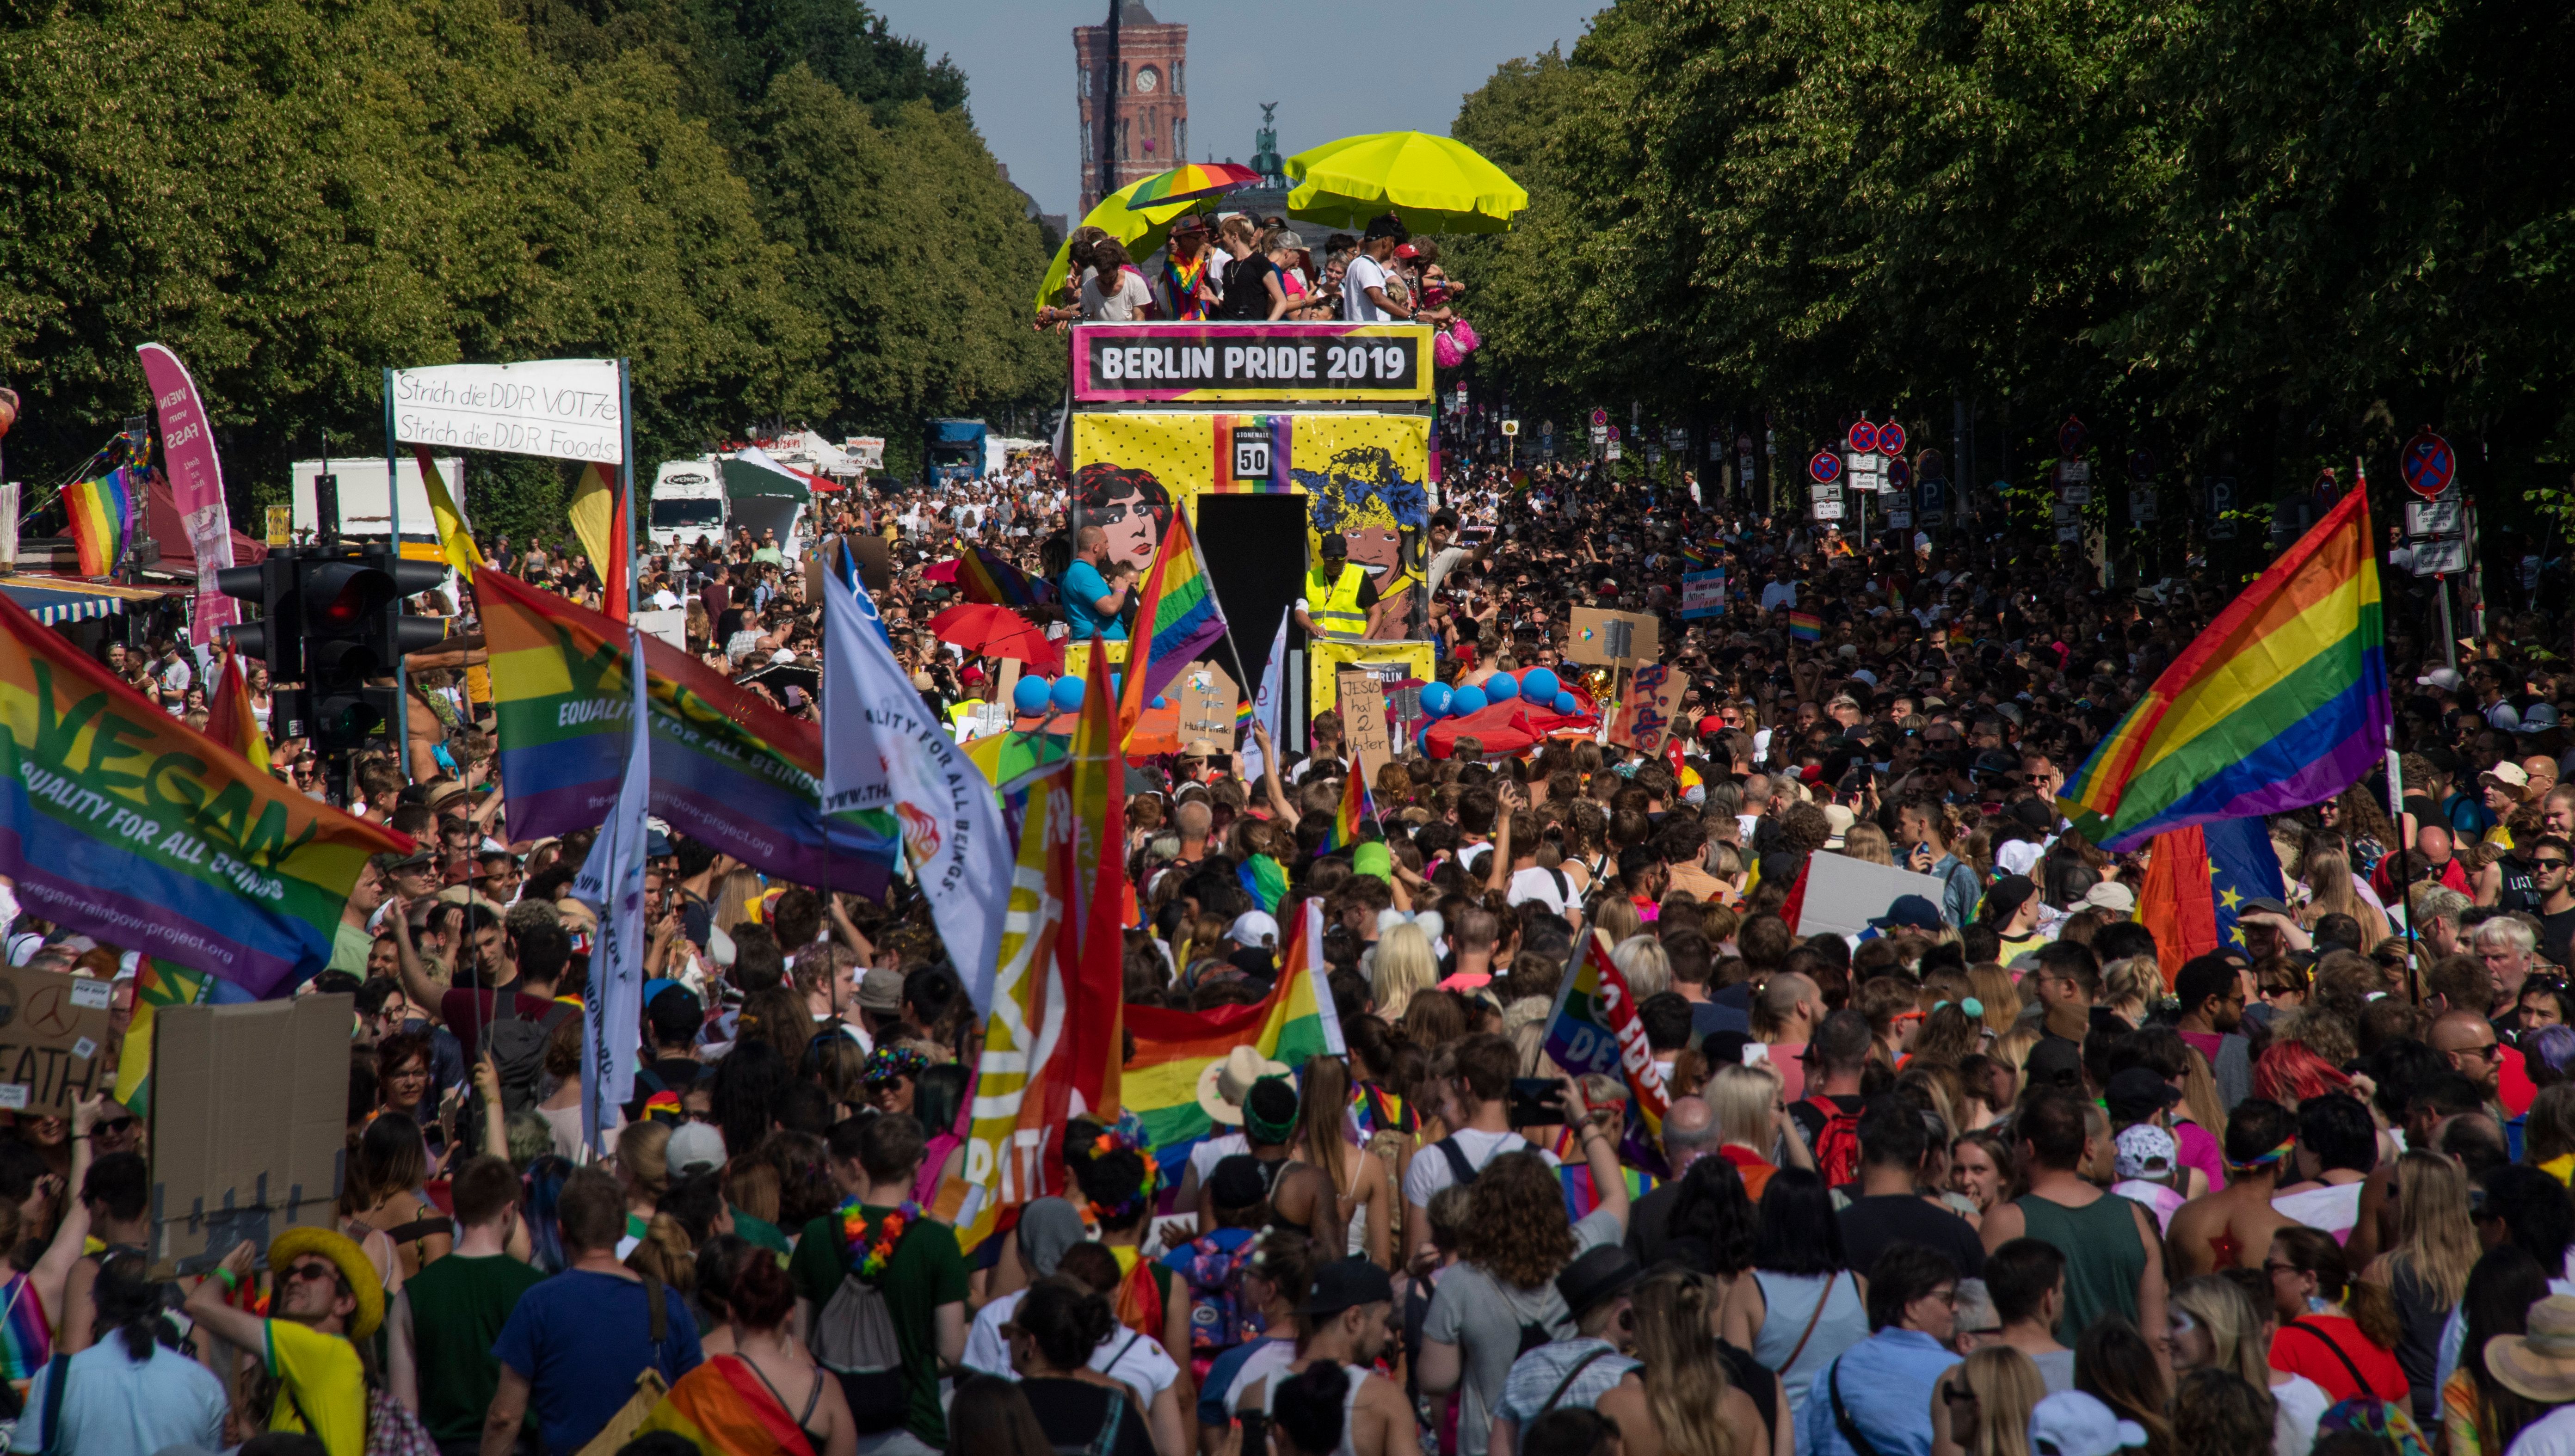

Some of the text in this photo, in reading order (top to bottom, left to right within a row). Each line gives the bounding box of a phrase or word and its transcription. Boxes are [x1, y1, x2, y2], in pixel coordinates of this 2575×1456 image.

[1102, 346, 1405, 379] BERLIN PRIDE 2019
[397, 375, 454, 404] Strich
[460, 384, 487, 406] die
[490, 383, 535, 411] DDR
[399, 415, 616, 460] Strich die DDR Foods
[1240, 449, 1266, 471] 50
[1342, 679, 1380, 696] JESUS
[1380, 672, 1402, 683] RLIN
[1351, 696, 1373, 713] hat
[1631, 663, 1669, 751] Pride
[656, 715, 700, 743] FOR
[1357, 714, 1374, 731] 2
[30, 657, 319, 873] VEGAN
[705, 738, 742, 762] ALL
[918, 729, 953, 768] FOR
[947, 773, 970, 813] ALL
[106, 807, 160, 846] FOR
[158, 831, 207, 866] ALL
